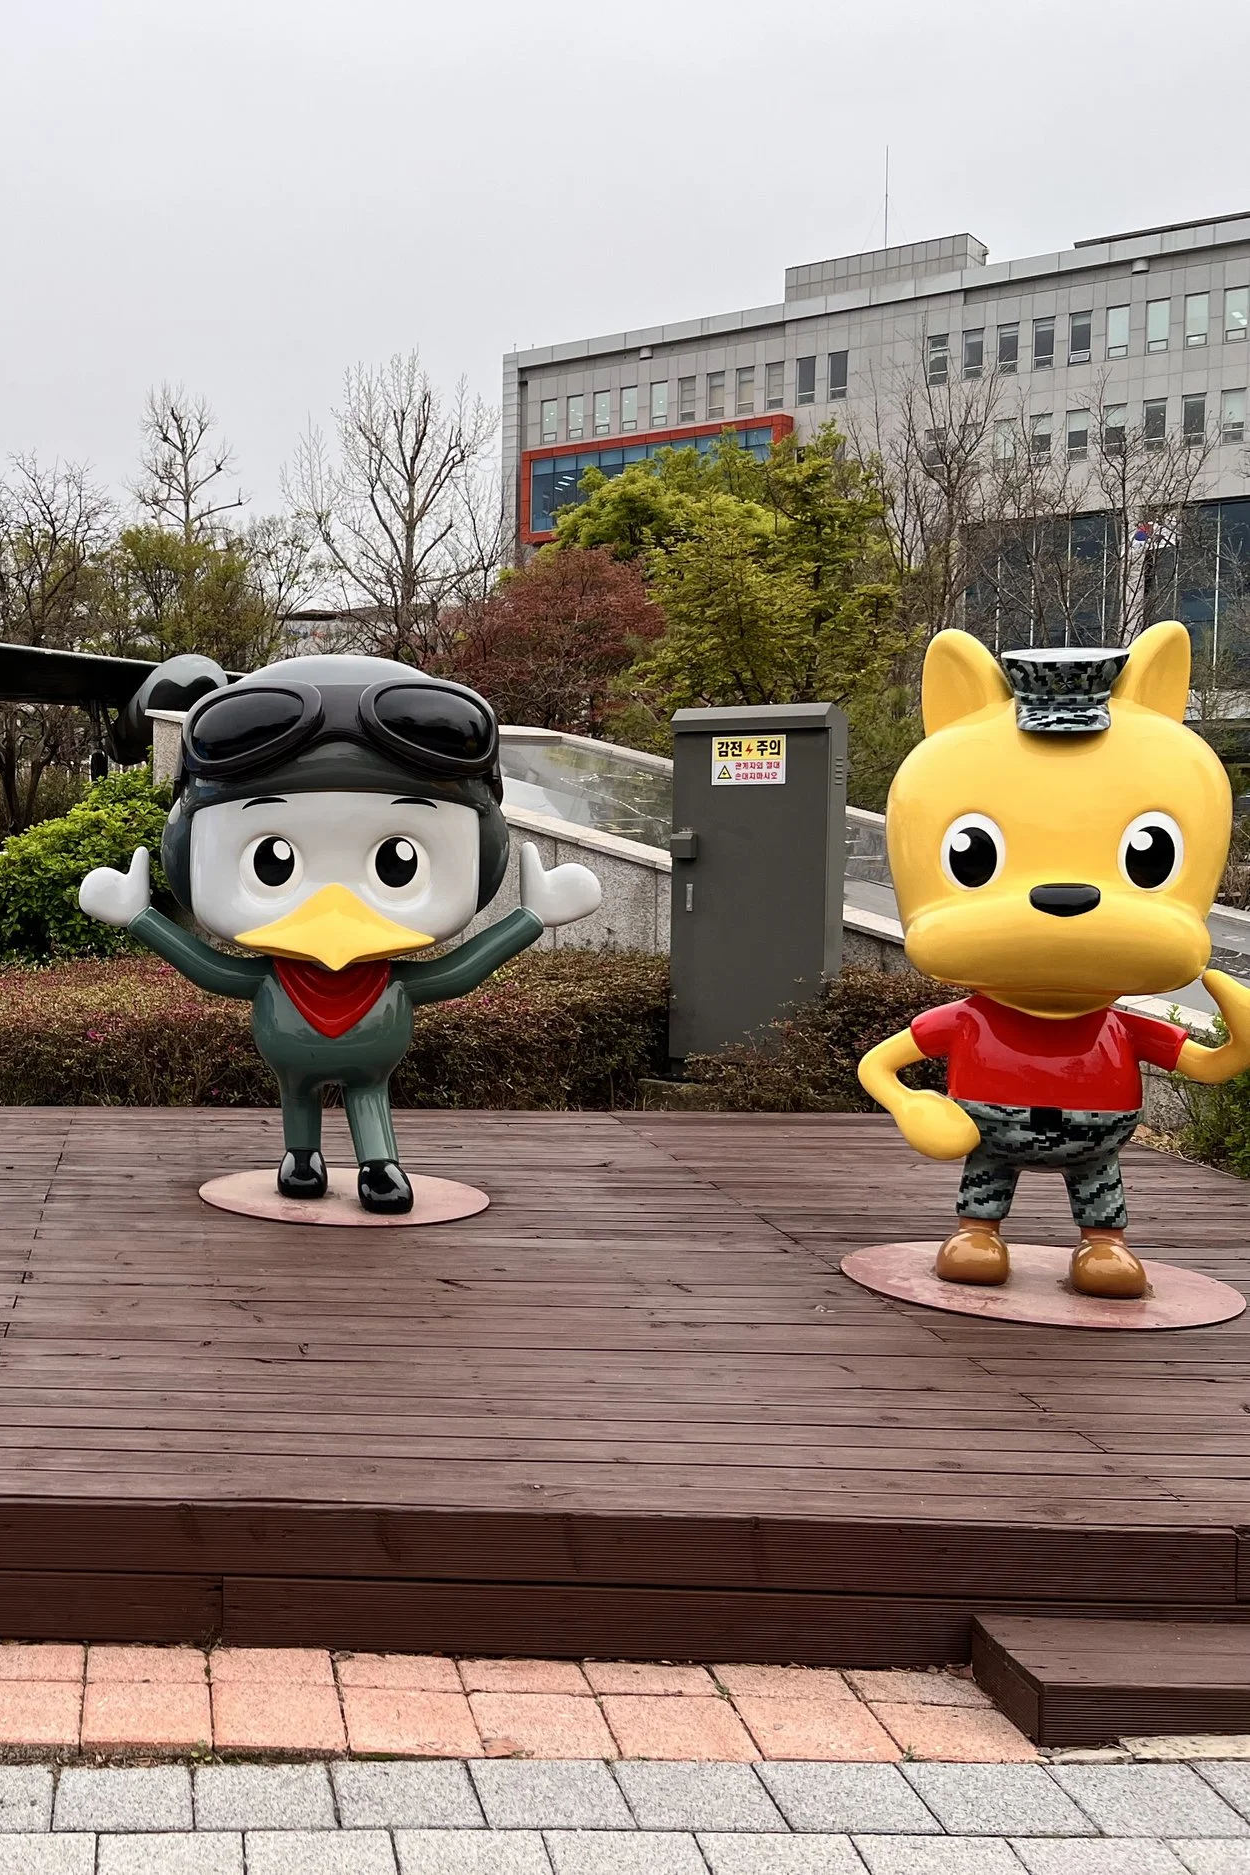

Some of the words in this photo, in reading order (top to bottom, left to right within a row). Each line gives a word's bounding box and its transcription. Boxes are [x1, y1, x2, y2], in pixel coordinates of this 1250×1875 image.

[717, 741, 743, 758] 감전
[756, 739, 781, 757] 주의
[734, 771, 778, 781] 손대지마시오
